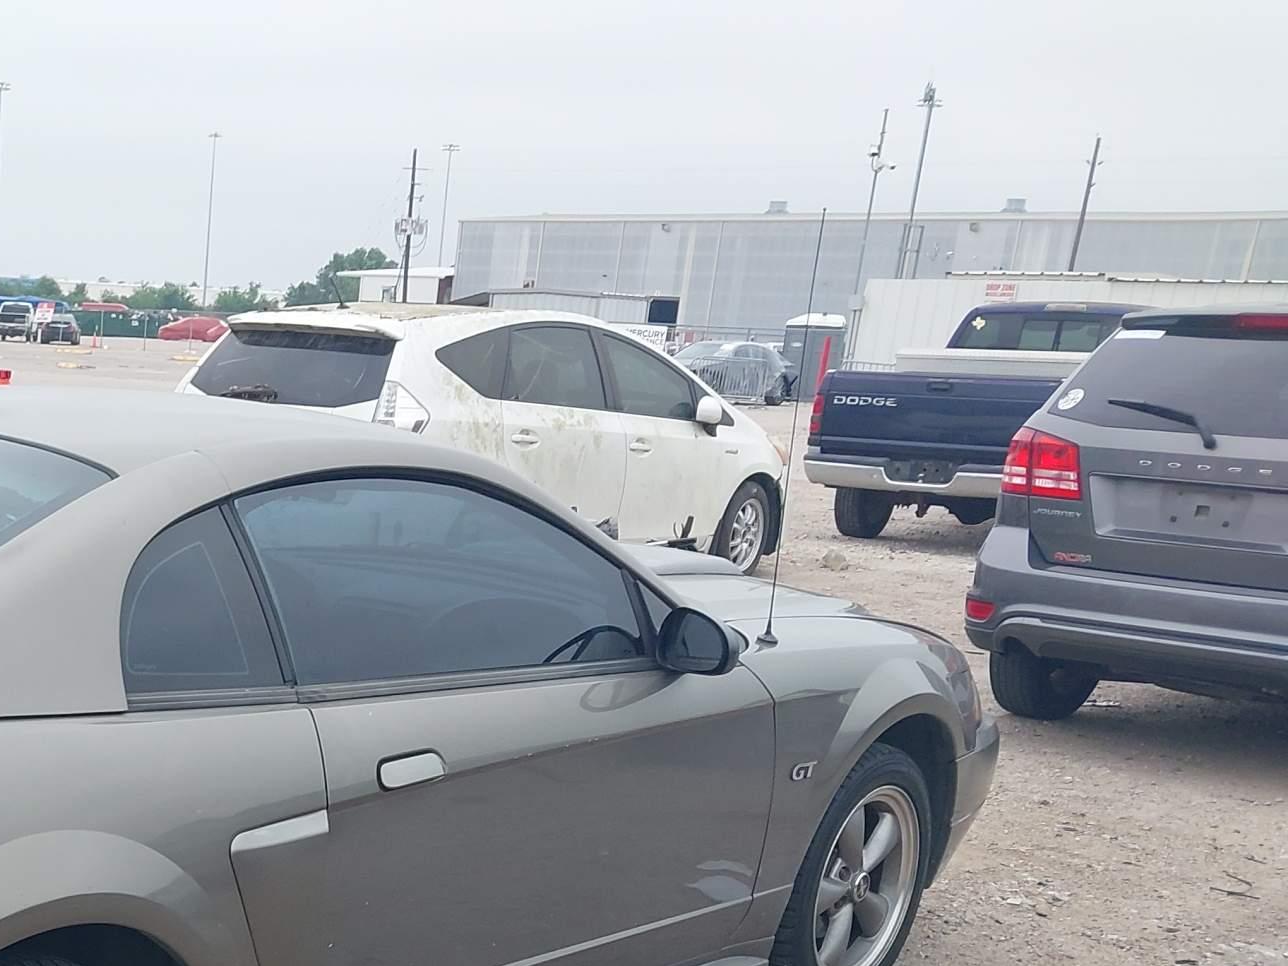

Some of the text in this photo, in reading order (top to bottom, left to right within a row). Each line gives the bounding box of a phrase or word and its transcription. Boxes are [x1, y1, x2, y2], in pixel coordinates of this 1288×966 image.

[833, 395, 898, 407] DODGE
[1139, 460, 1273, 475] DODGE
[1032, 508, 1081, 518] JOURNEY
[792, 760, 818, 780] GT
